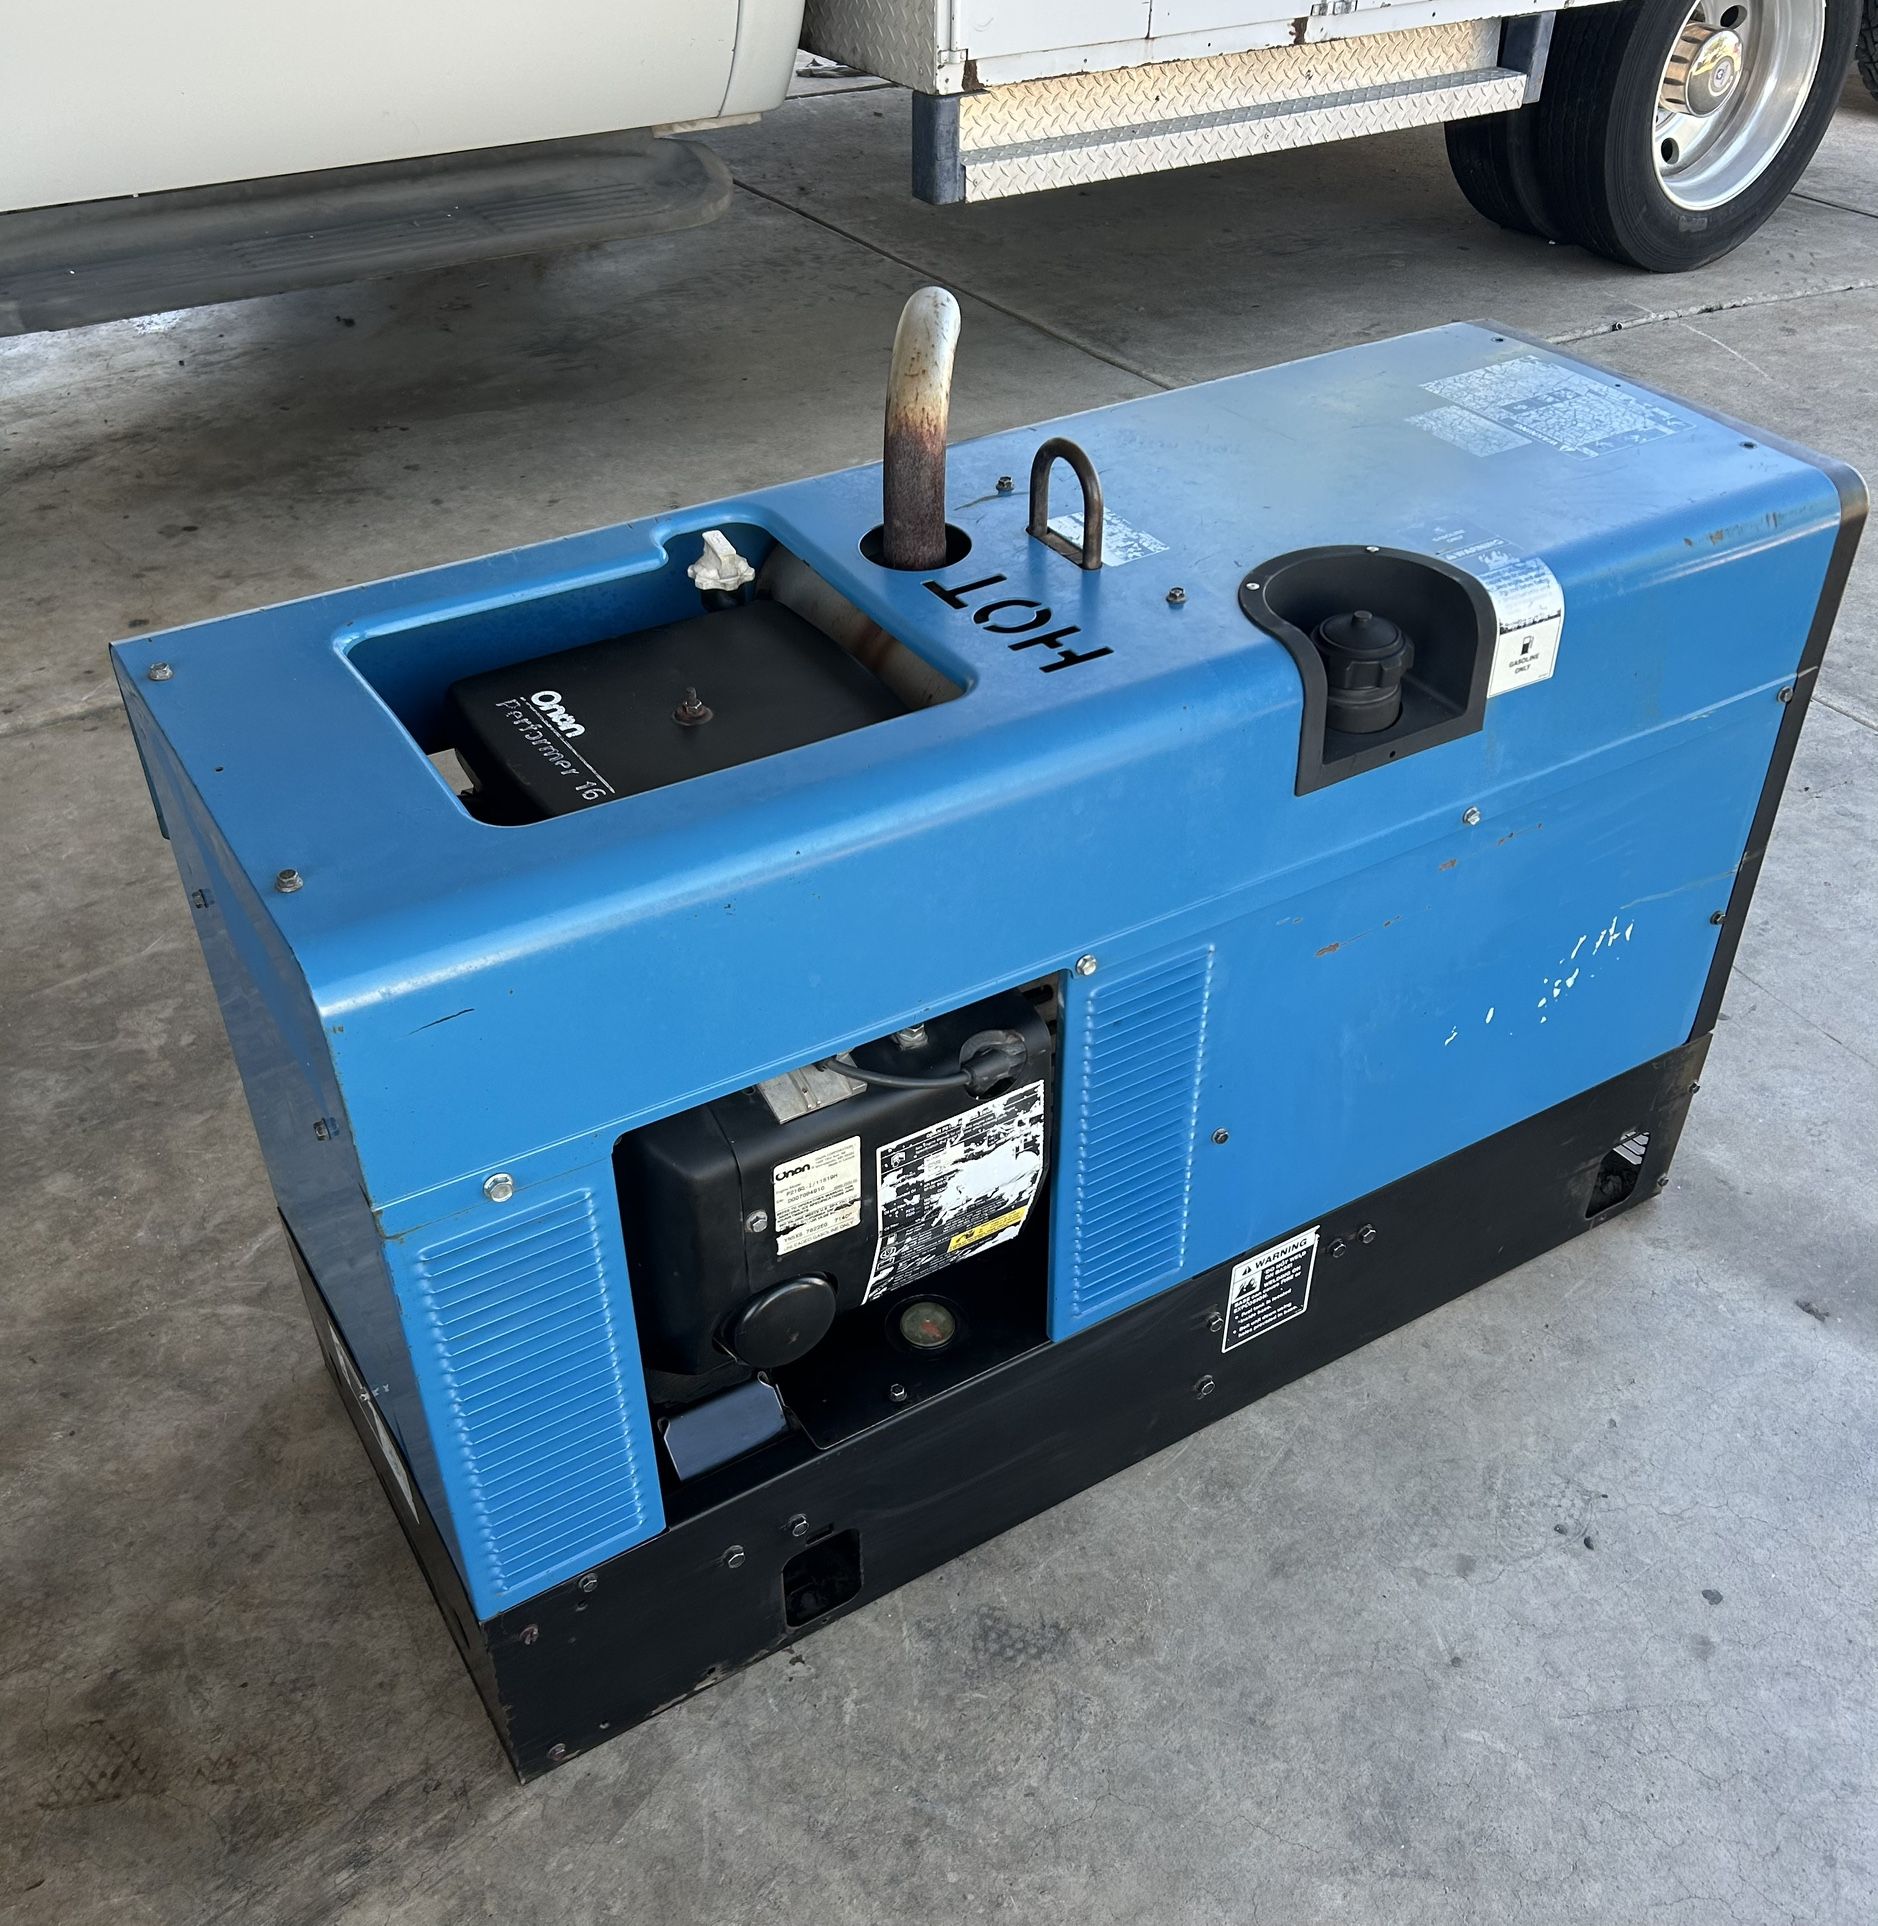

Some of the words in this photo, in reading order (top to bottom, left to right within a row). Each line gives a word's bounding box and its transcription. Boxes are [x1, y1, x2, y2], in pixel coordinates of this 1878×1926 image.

[922, 572, 1114, 674] HOT
[1508, 652, 1540, 669] GASOLINE
[1514, 663, 1531, 675] ONLY
[531, 690, 586, 738] Onan
[496, 698, 580, 776] Performer
[575, 781, 607, 800] 16
[775, 1163, 811, 1181] Onan
[1255, 1238, 1308, 1269] WARNING
